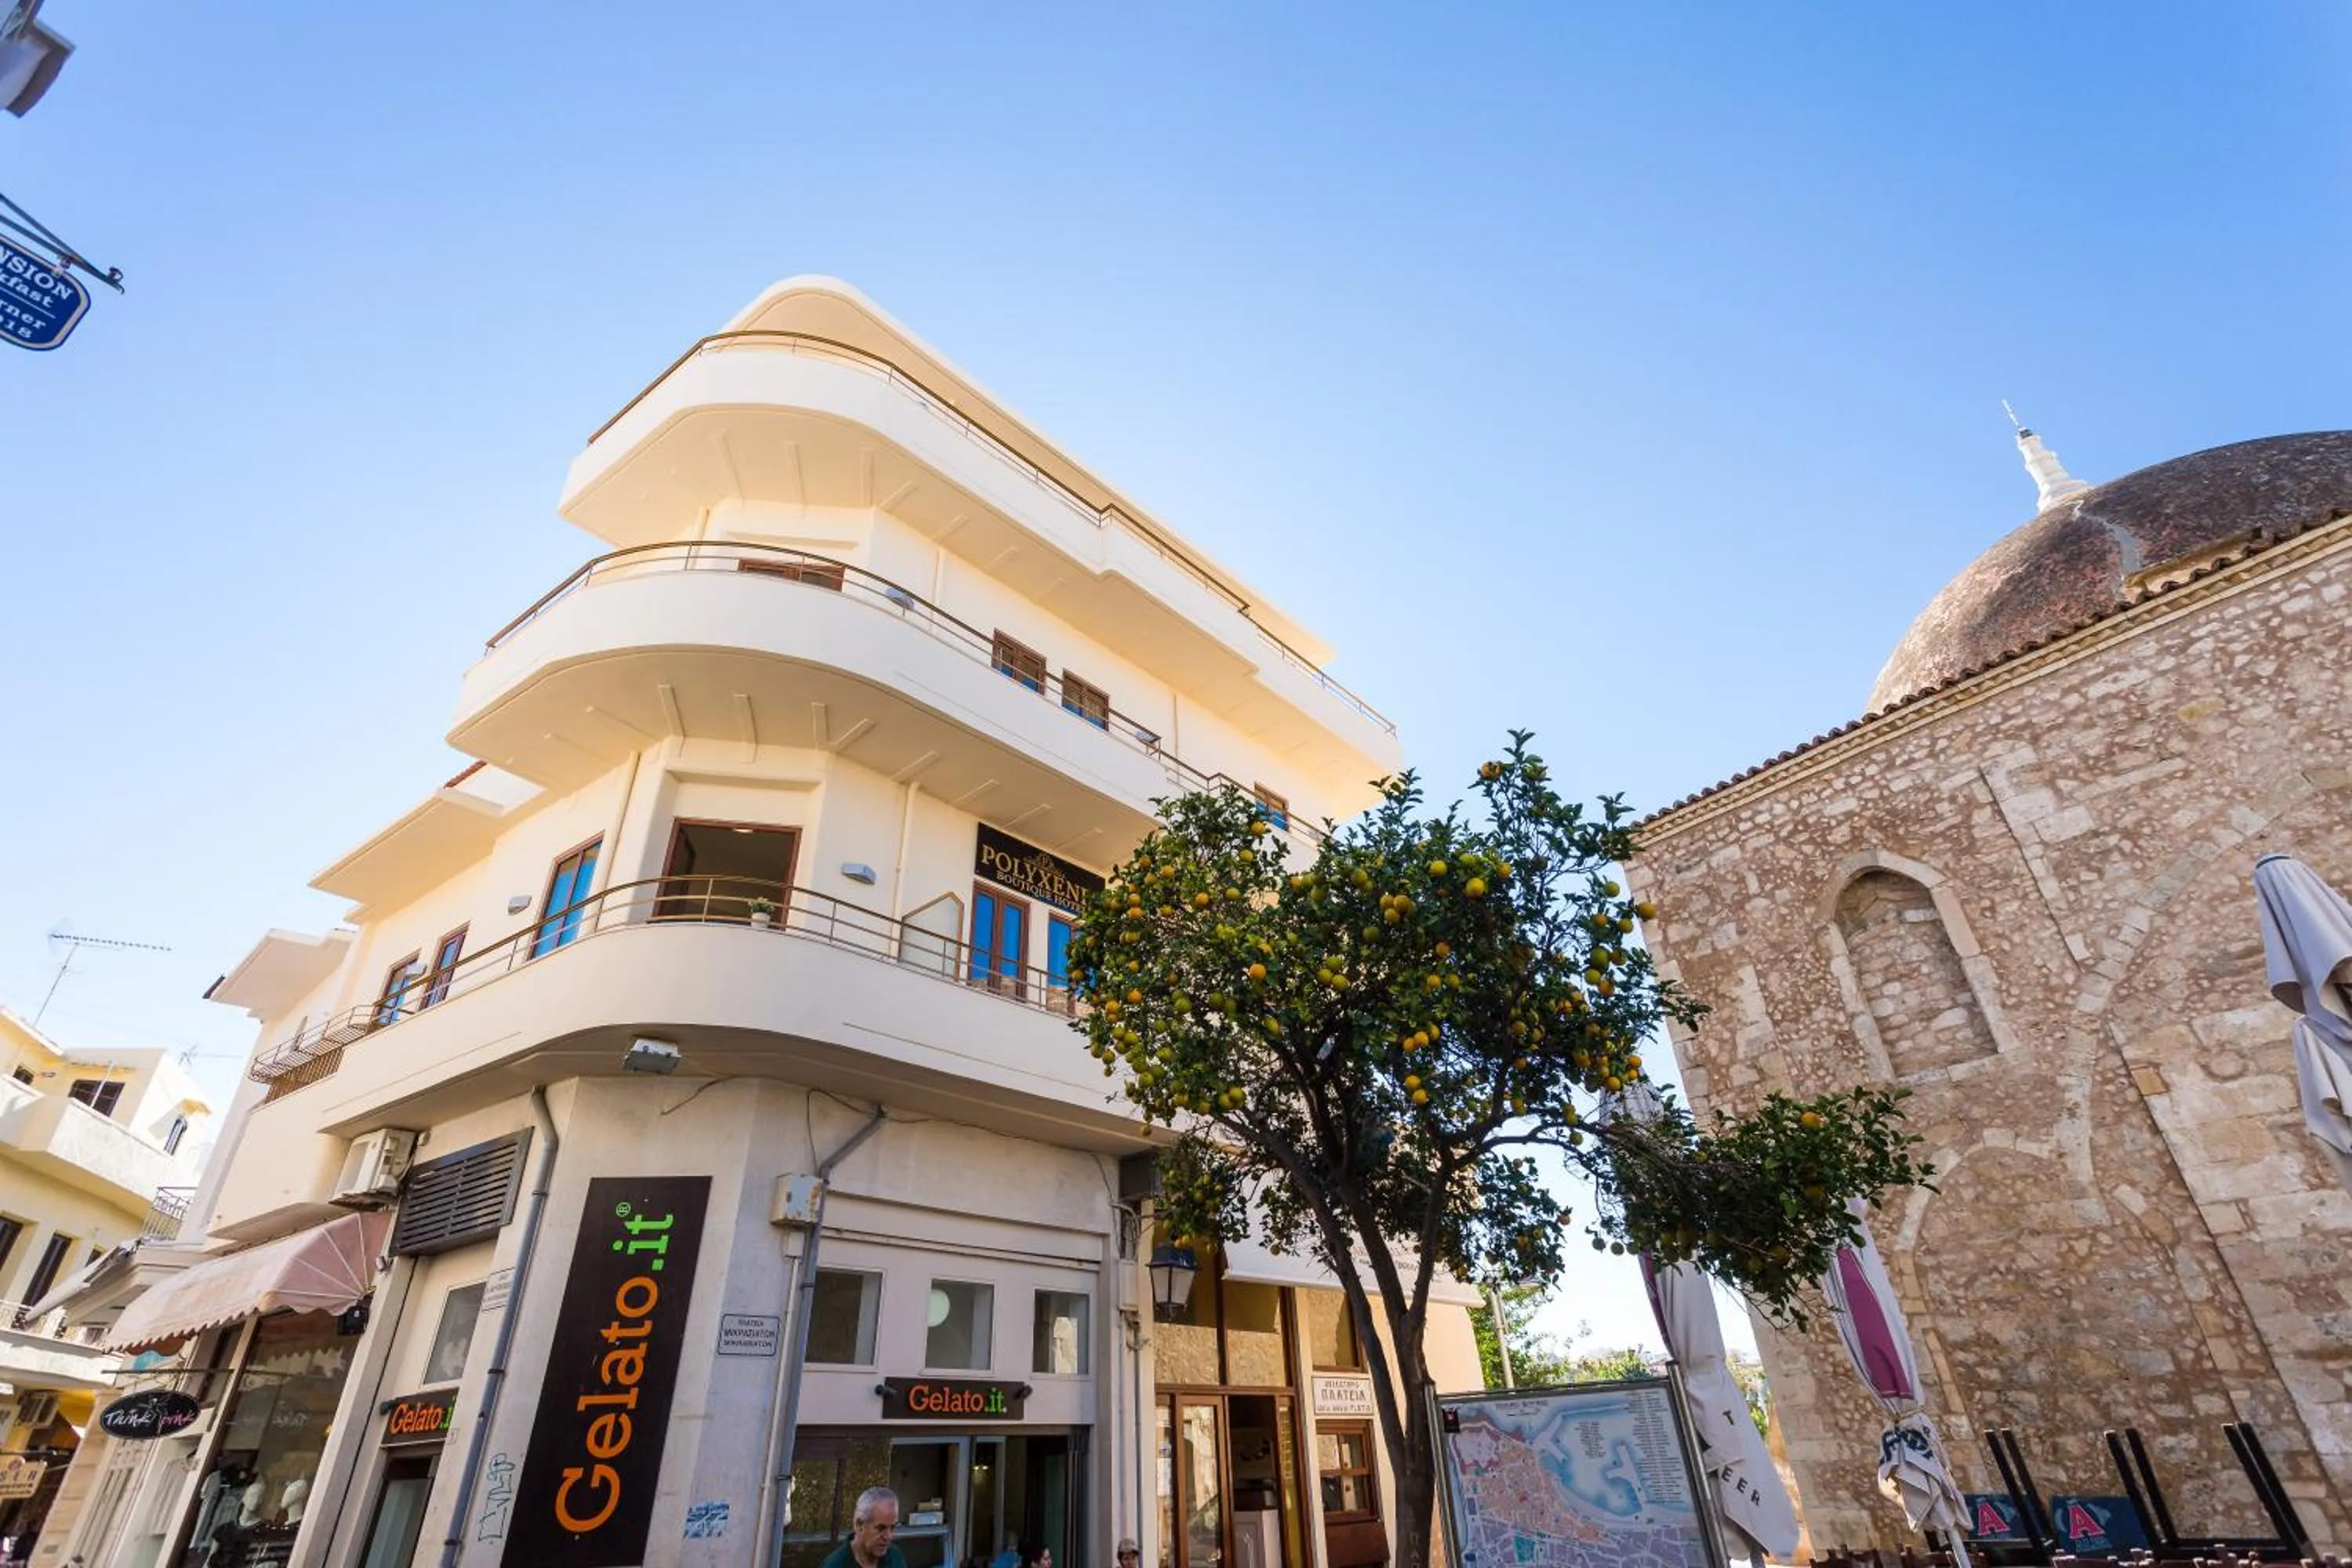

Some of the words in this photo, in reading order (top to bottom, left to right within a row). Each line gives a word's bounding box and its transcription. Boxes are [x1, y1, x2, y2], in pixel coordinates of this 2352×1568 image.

[996, 870, 1052, 901] BOUTIQUE
[554, 1214, 674, 1532] Gelato.it
[909, 1385, 1004, 1413] Gelato.it
[104, 1409, 151, 1427] Think
